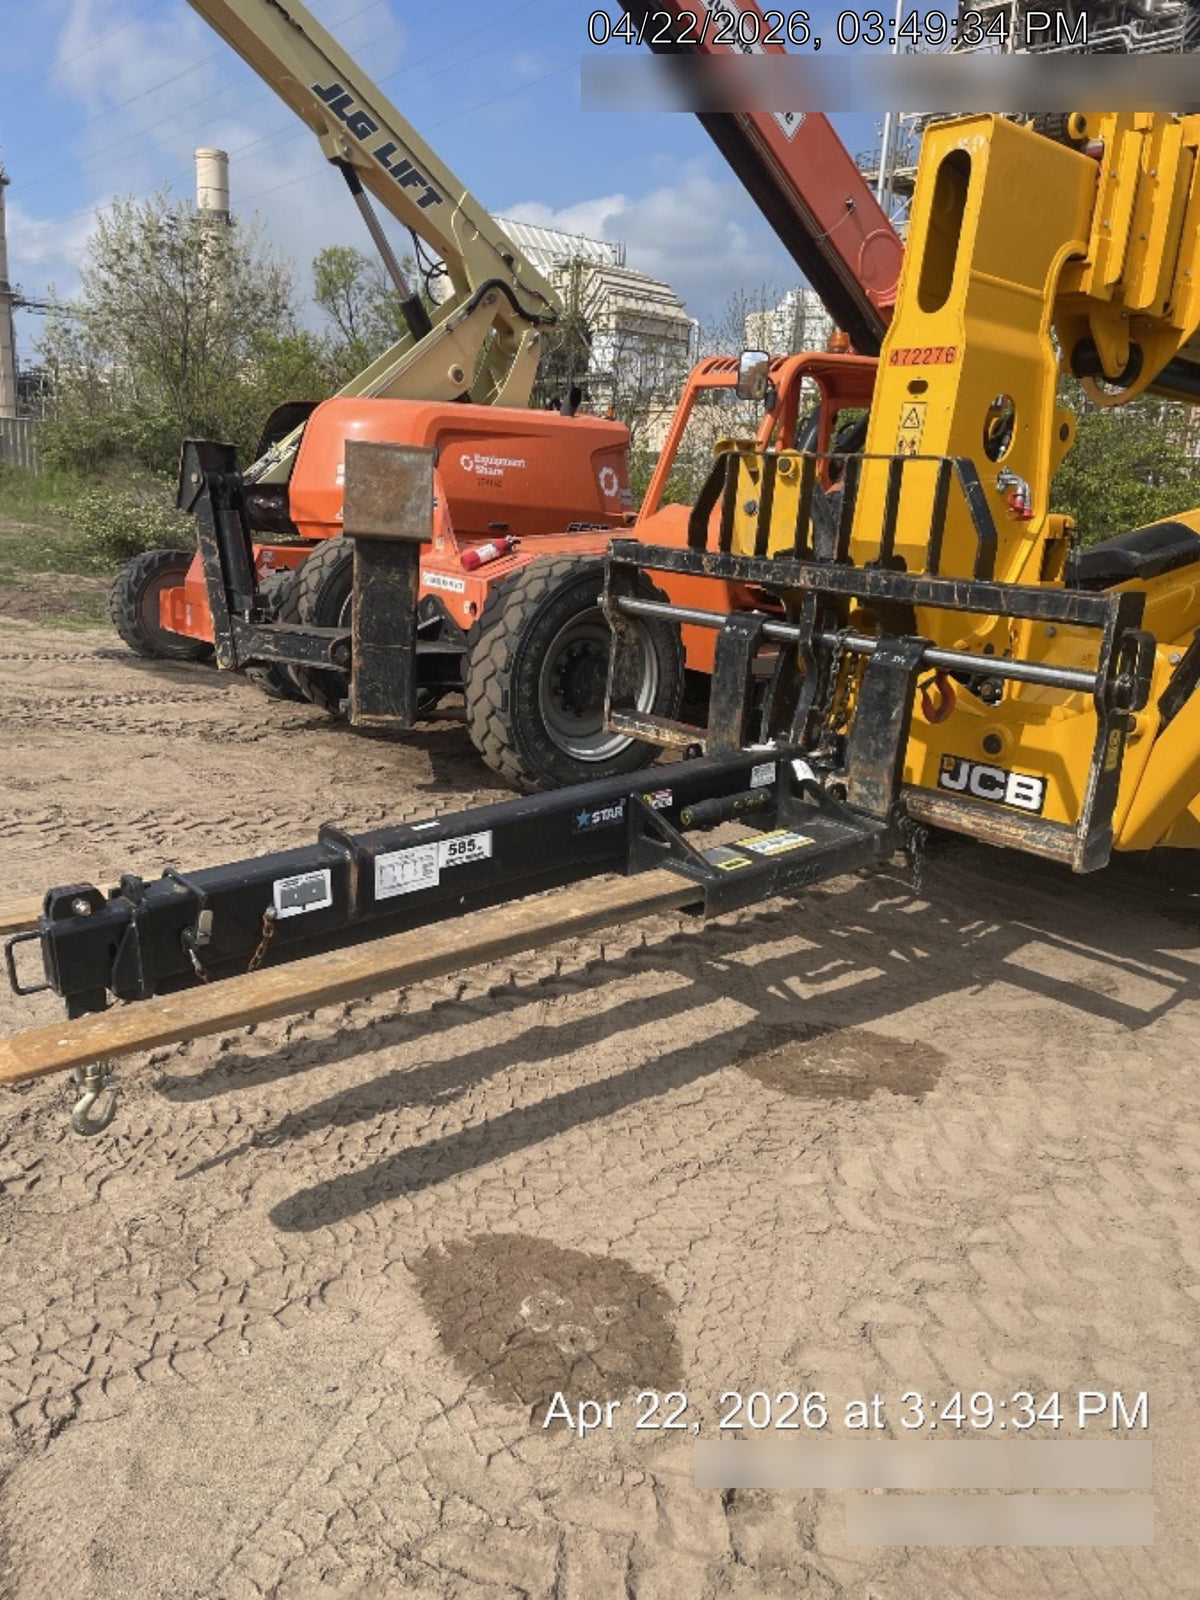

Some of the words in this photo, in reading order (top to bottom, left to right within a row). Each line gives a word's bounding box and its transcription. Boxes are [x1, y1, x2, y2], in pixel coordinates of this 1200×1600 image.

[311, 83, 380, 141] JLG
[373, 141, 444, 209] LIFT
[890, 346, 956, 366] 472276
[940, 760, 1043, 810] JCB
[591, 806, 624, 824] STAR
